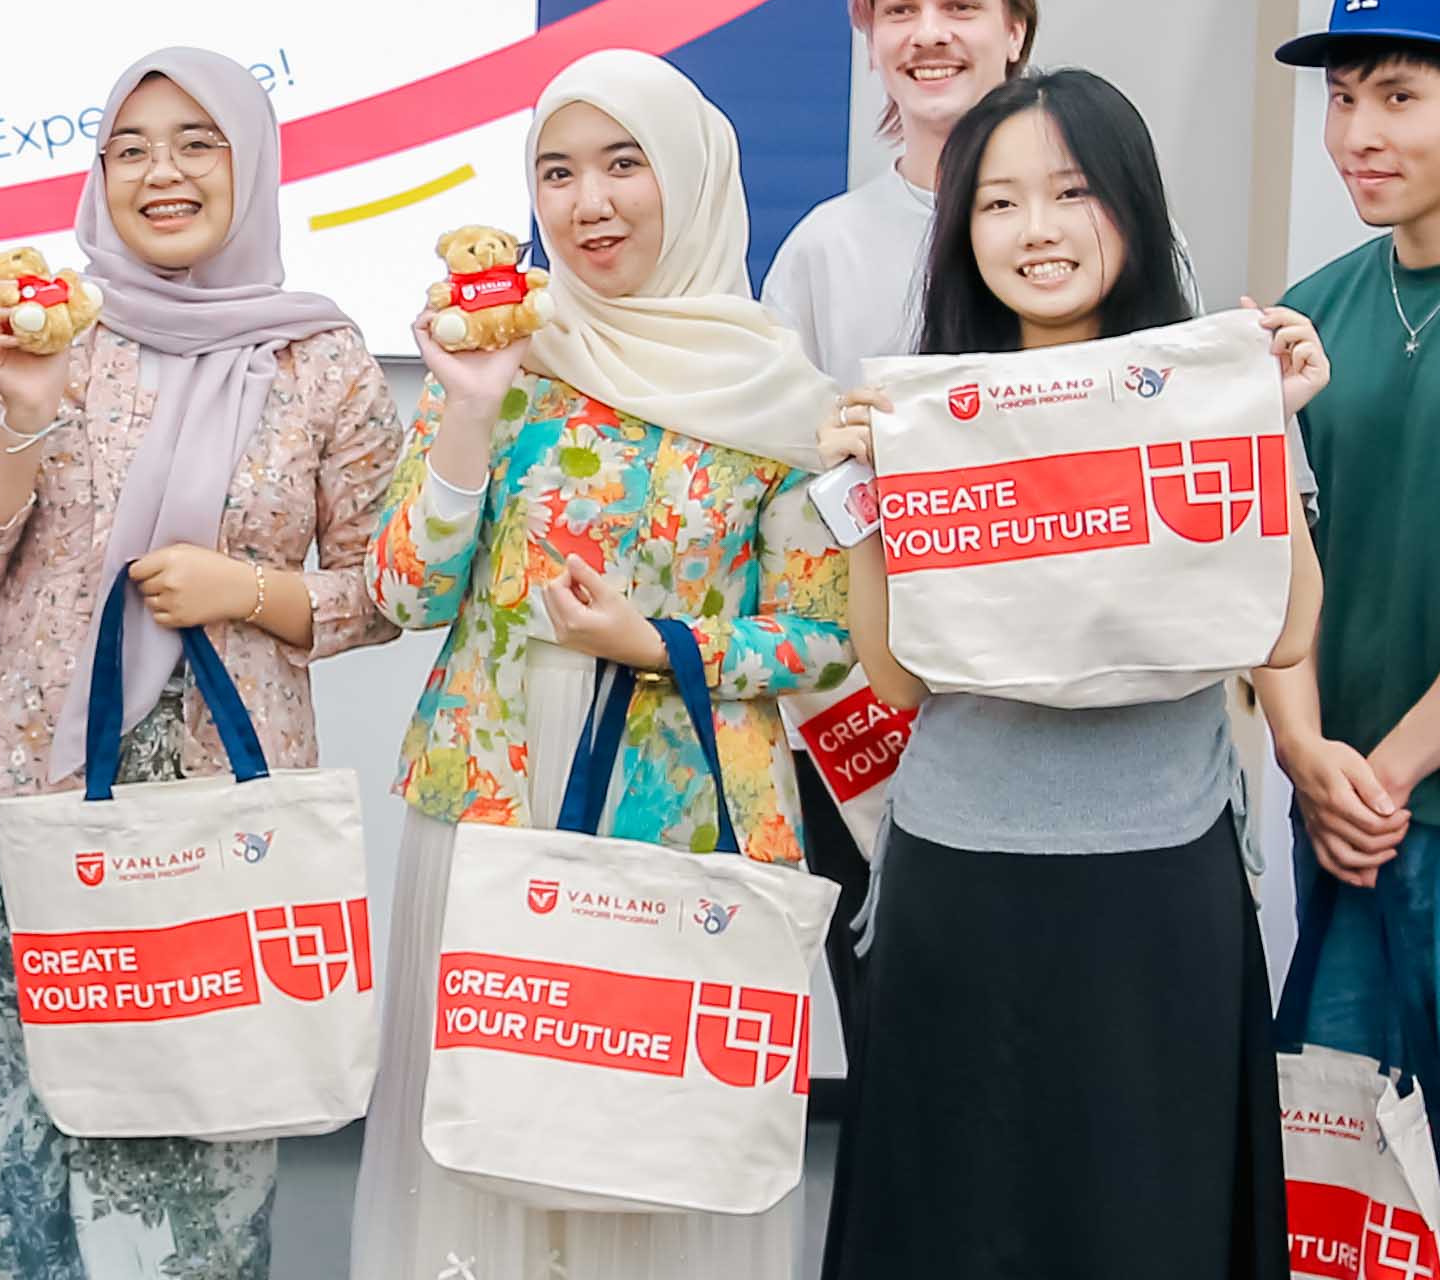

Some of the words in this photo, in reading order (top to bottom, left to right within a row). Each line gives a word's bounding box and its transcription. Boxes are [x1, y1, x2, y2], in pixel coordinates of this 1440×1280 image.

[988, 378, 1094, 398] VANLANG
[880, 479, 1017, 519] CREATE
[884, 526, 980, 559] YOUR
[990, 505, 1132, 549] FUTURE
[834, 730, 905, 783] YOUR
[111, 847, 206, 870] VANLANG
[567, 891, 666, 915] VANLANG
[22, 947, 139, 975] CREATE
[26, 985, 108, 1012] YOUR
[115, 968, 244, 1009] FUTURE
[444, 969, 571, 1008] CREATE
[445, 1006, 527, 1041] YOUR
[533, 1018, 673, 1062] FUTURE
[1288, 1233, 1359, 1272] TURE
